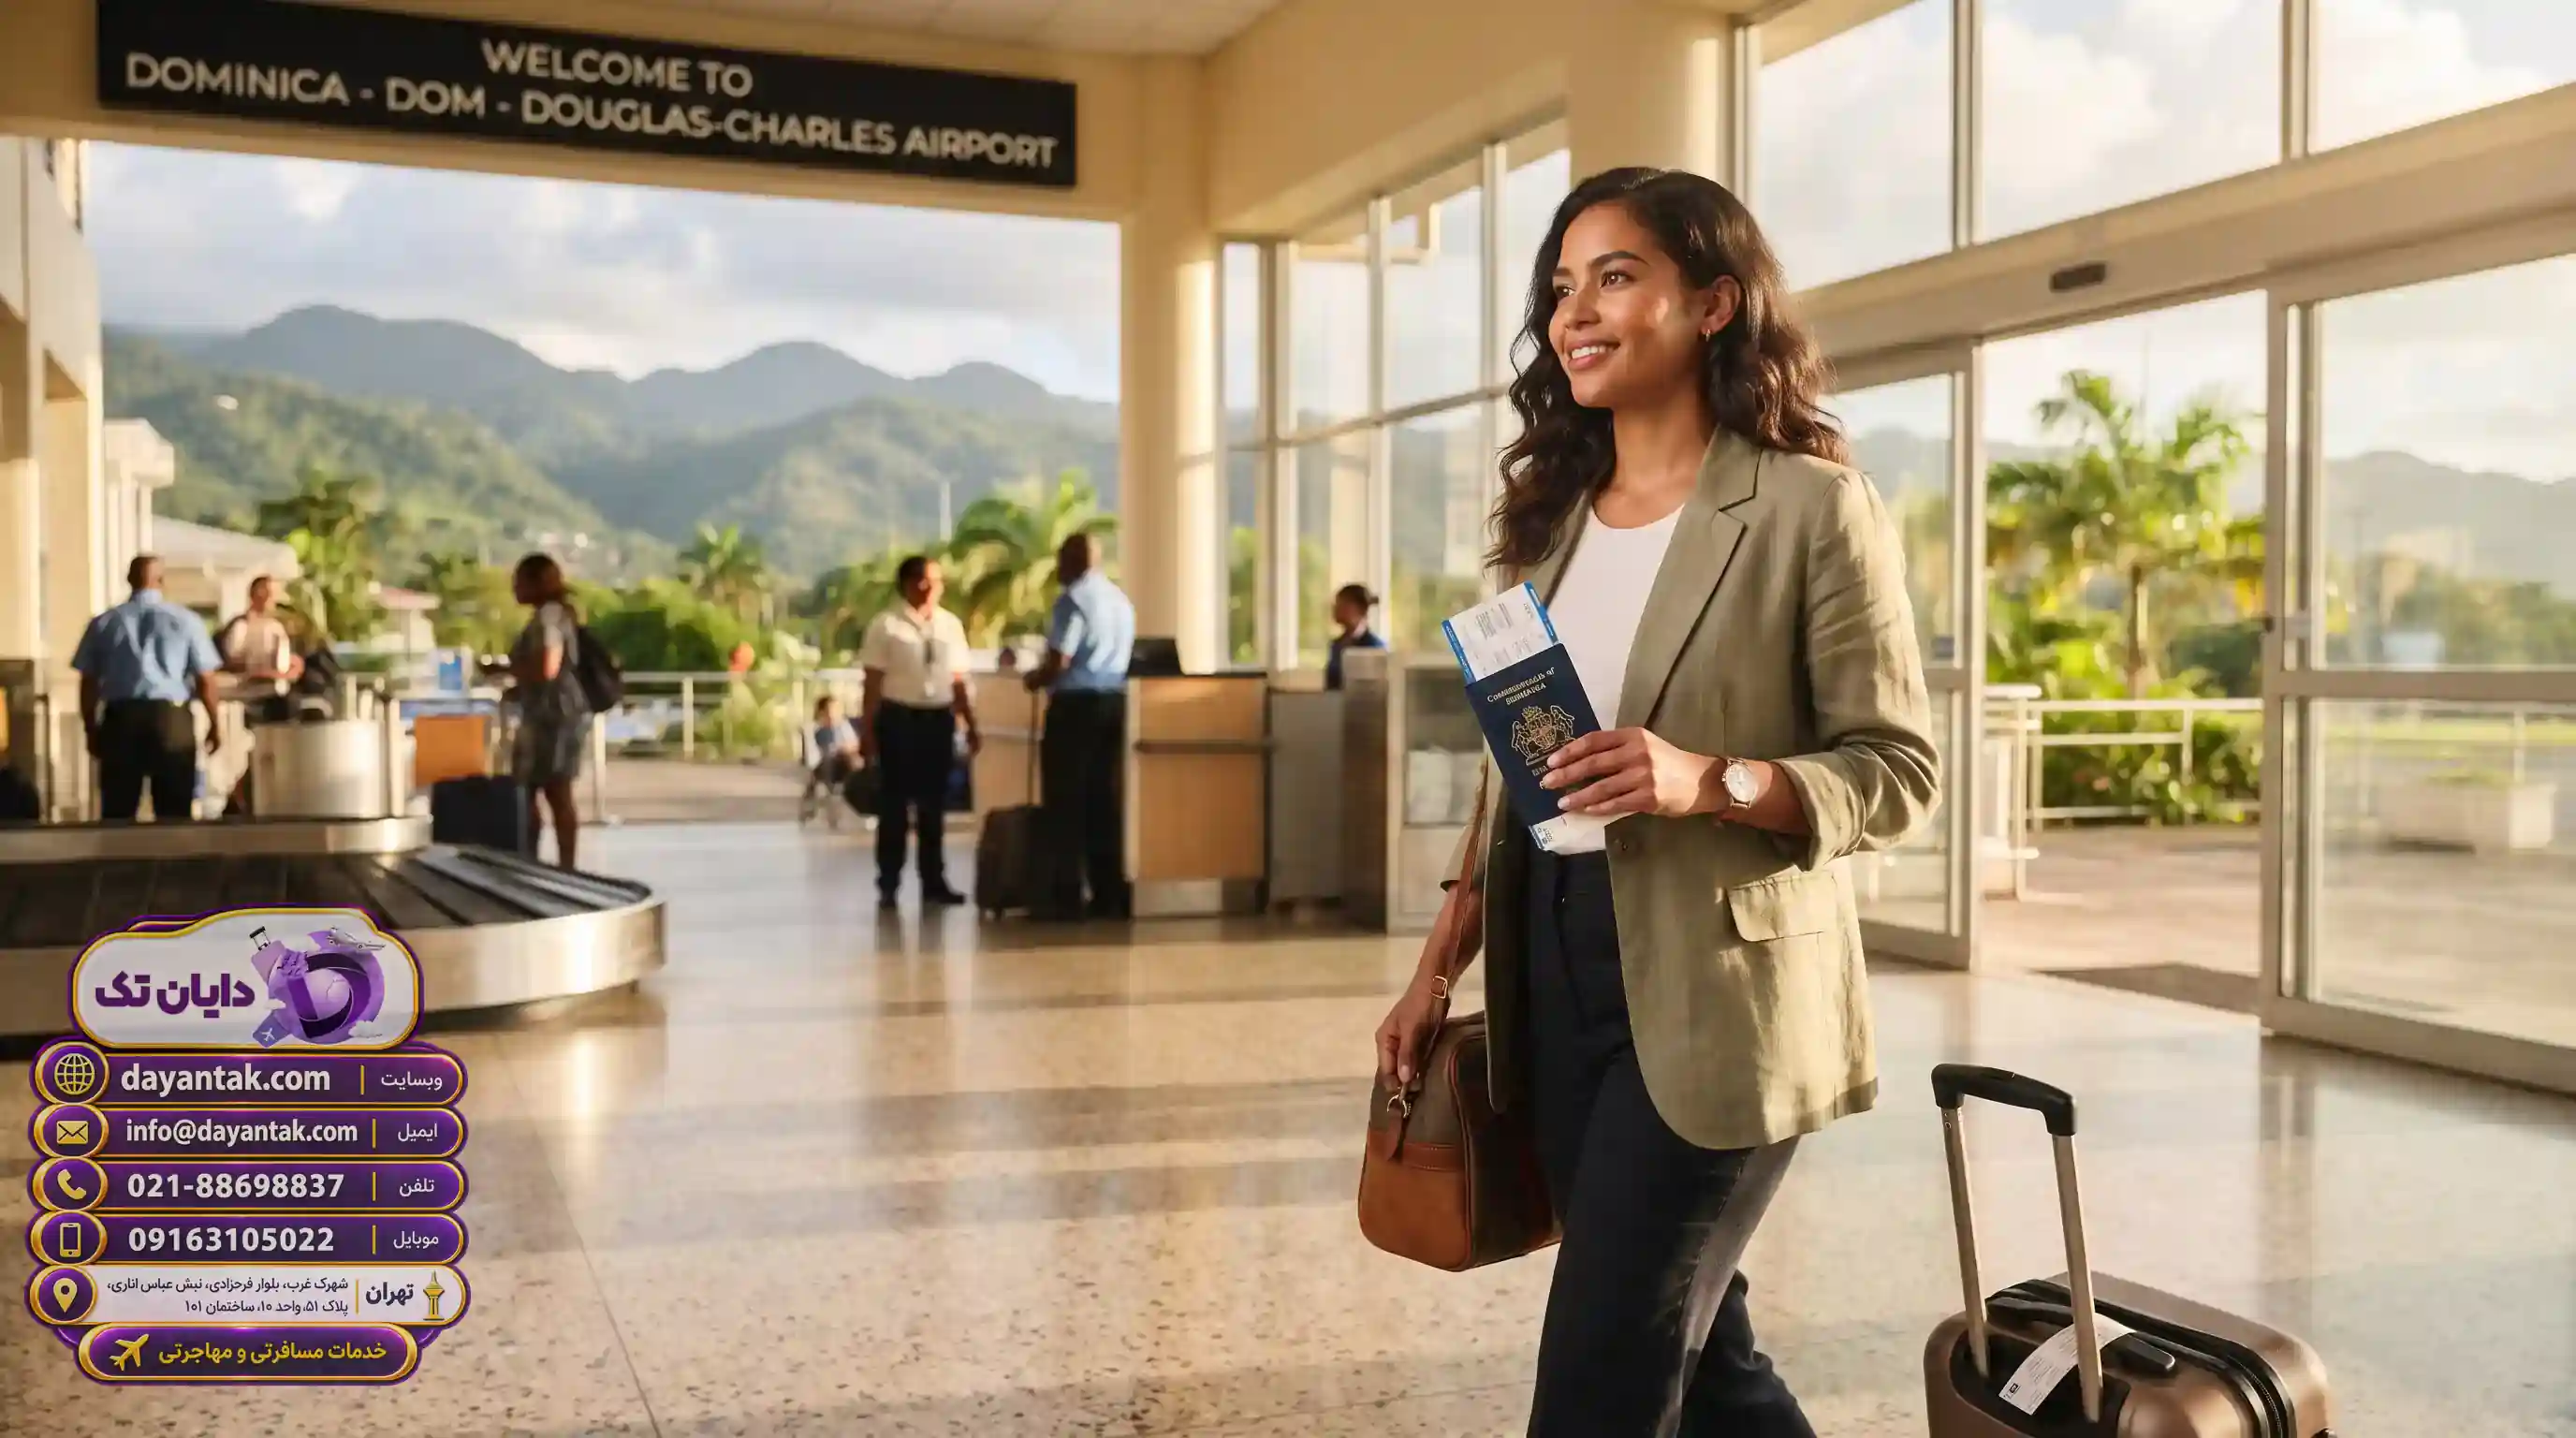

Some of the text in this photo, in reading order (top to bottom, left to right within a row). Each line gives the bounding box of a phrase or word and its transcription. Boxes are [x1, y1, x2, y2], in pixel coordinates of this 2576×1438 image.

[124, 51, 349, 106] DOMINICA
[387, 77, 486, 119] DOM
[520, 90, 897, 155] DOUGLAS-CHARLES
[902, 125, 1059, 169] AIRPORT
[481, 37, 753, 97] WELCOME TO
